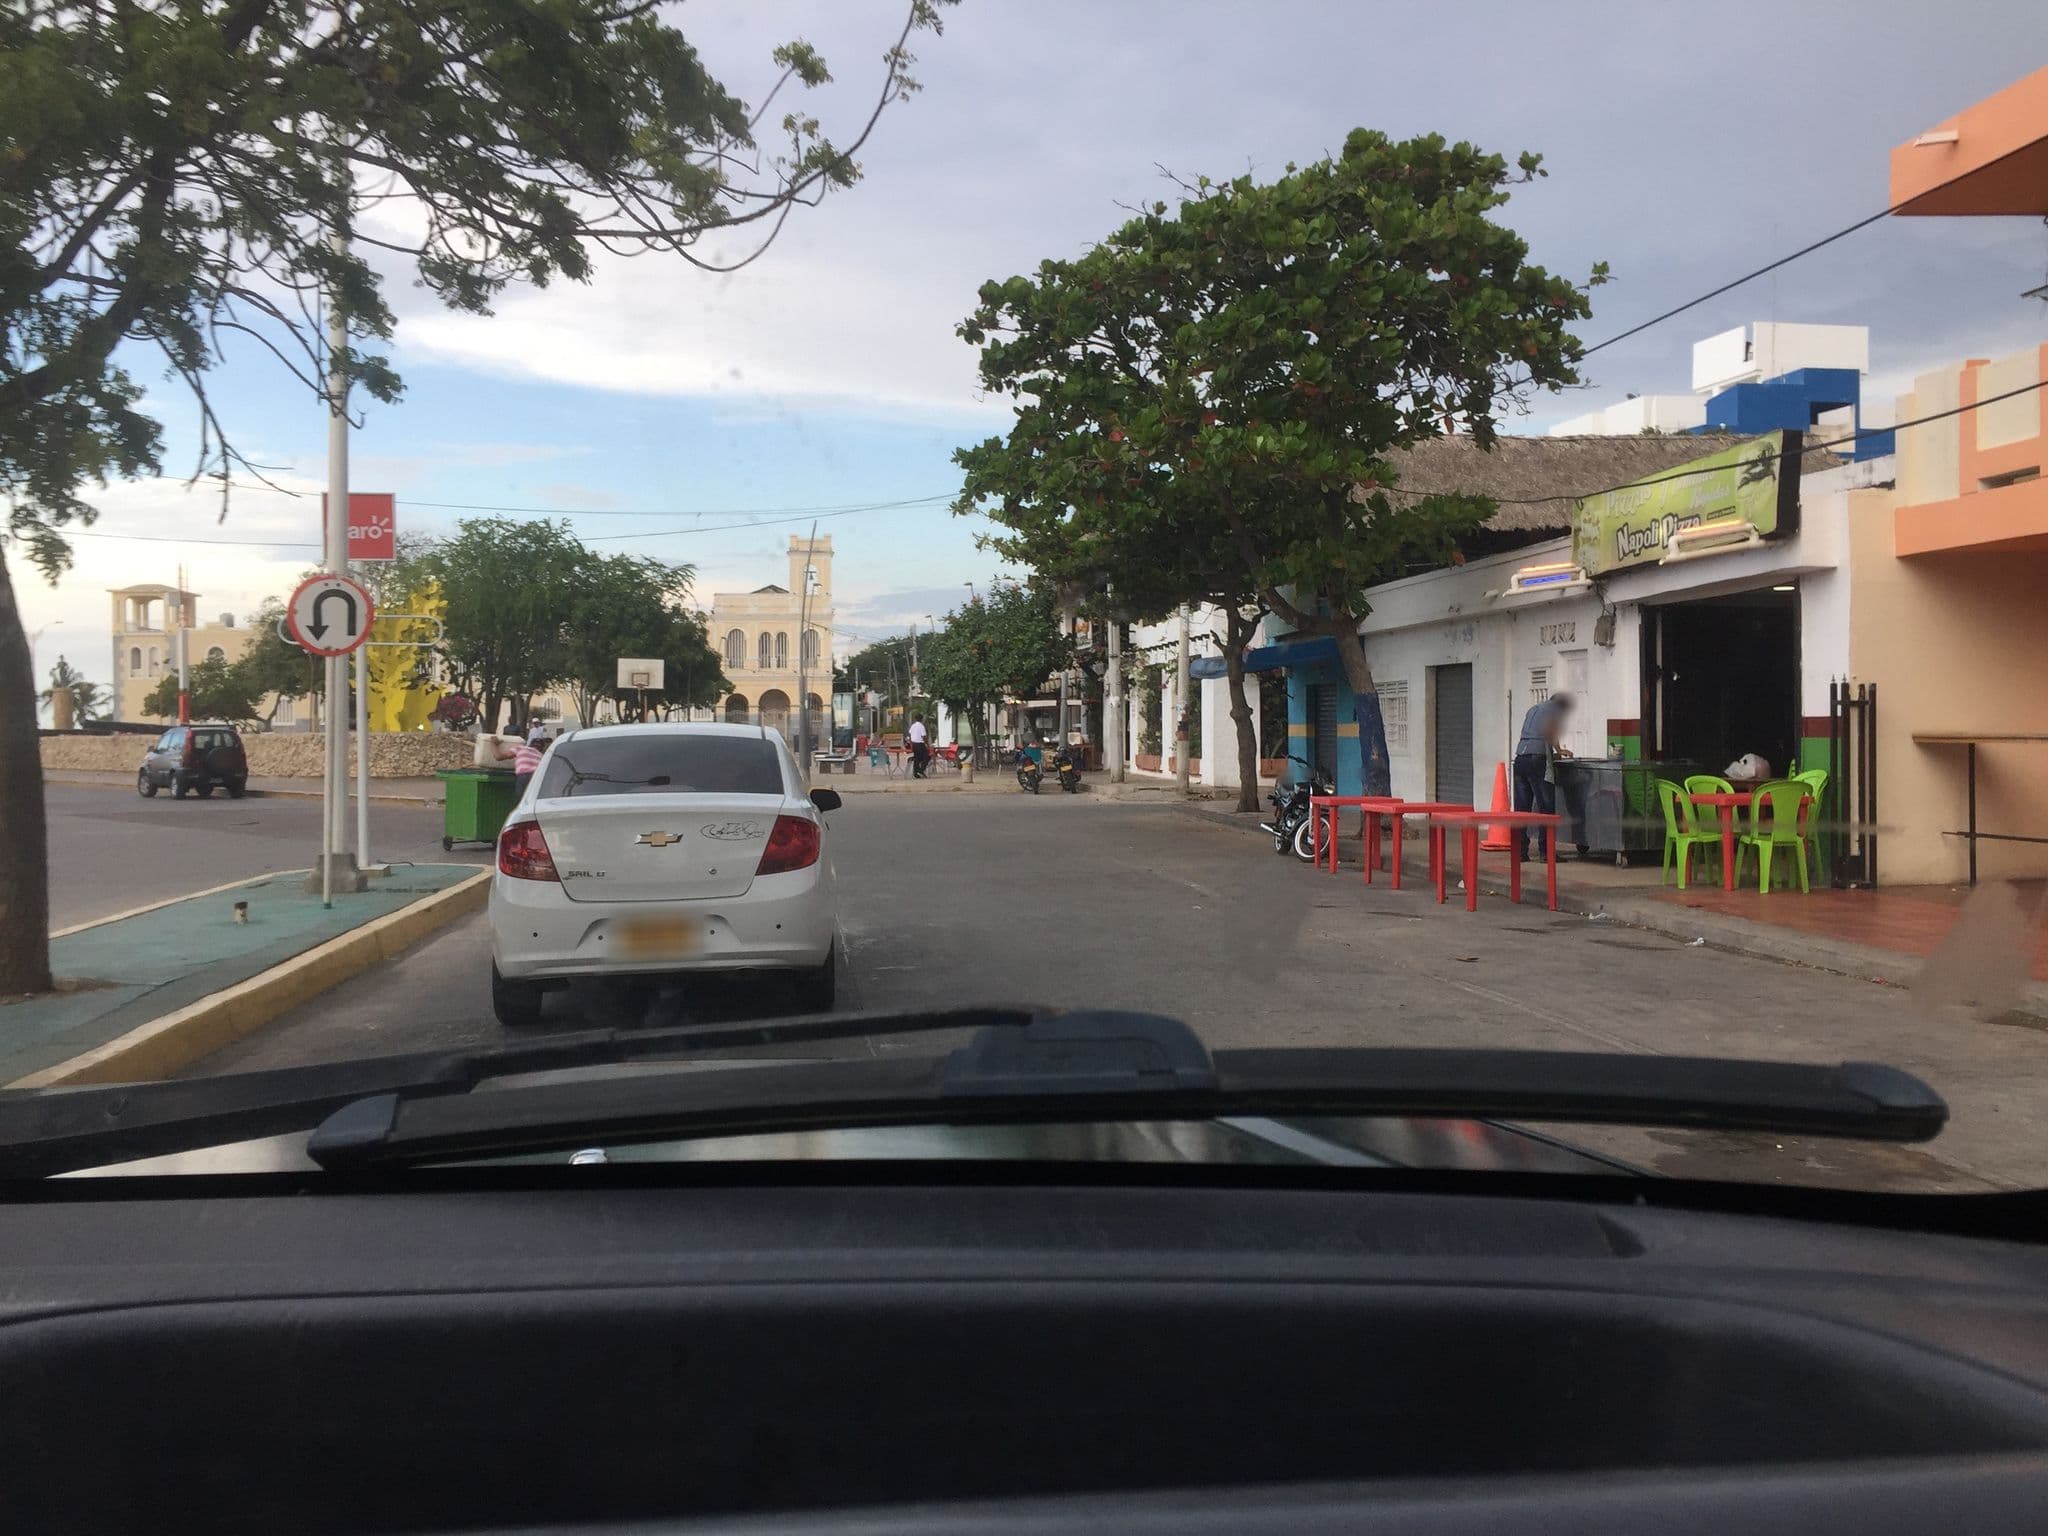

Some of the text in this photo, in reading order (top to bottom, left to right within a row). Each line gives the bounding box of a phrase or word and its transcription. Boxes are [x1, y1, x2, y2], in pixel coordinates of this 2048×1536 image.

[348, 525, 382, 539] aro
[1617, 521, 1659, 560] Napoli
[568, 870, 593, 878] SAIL
